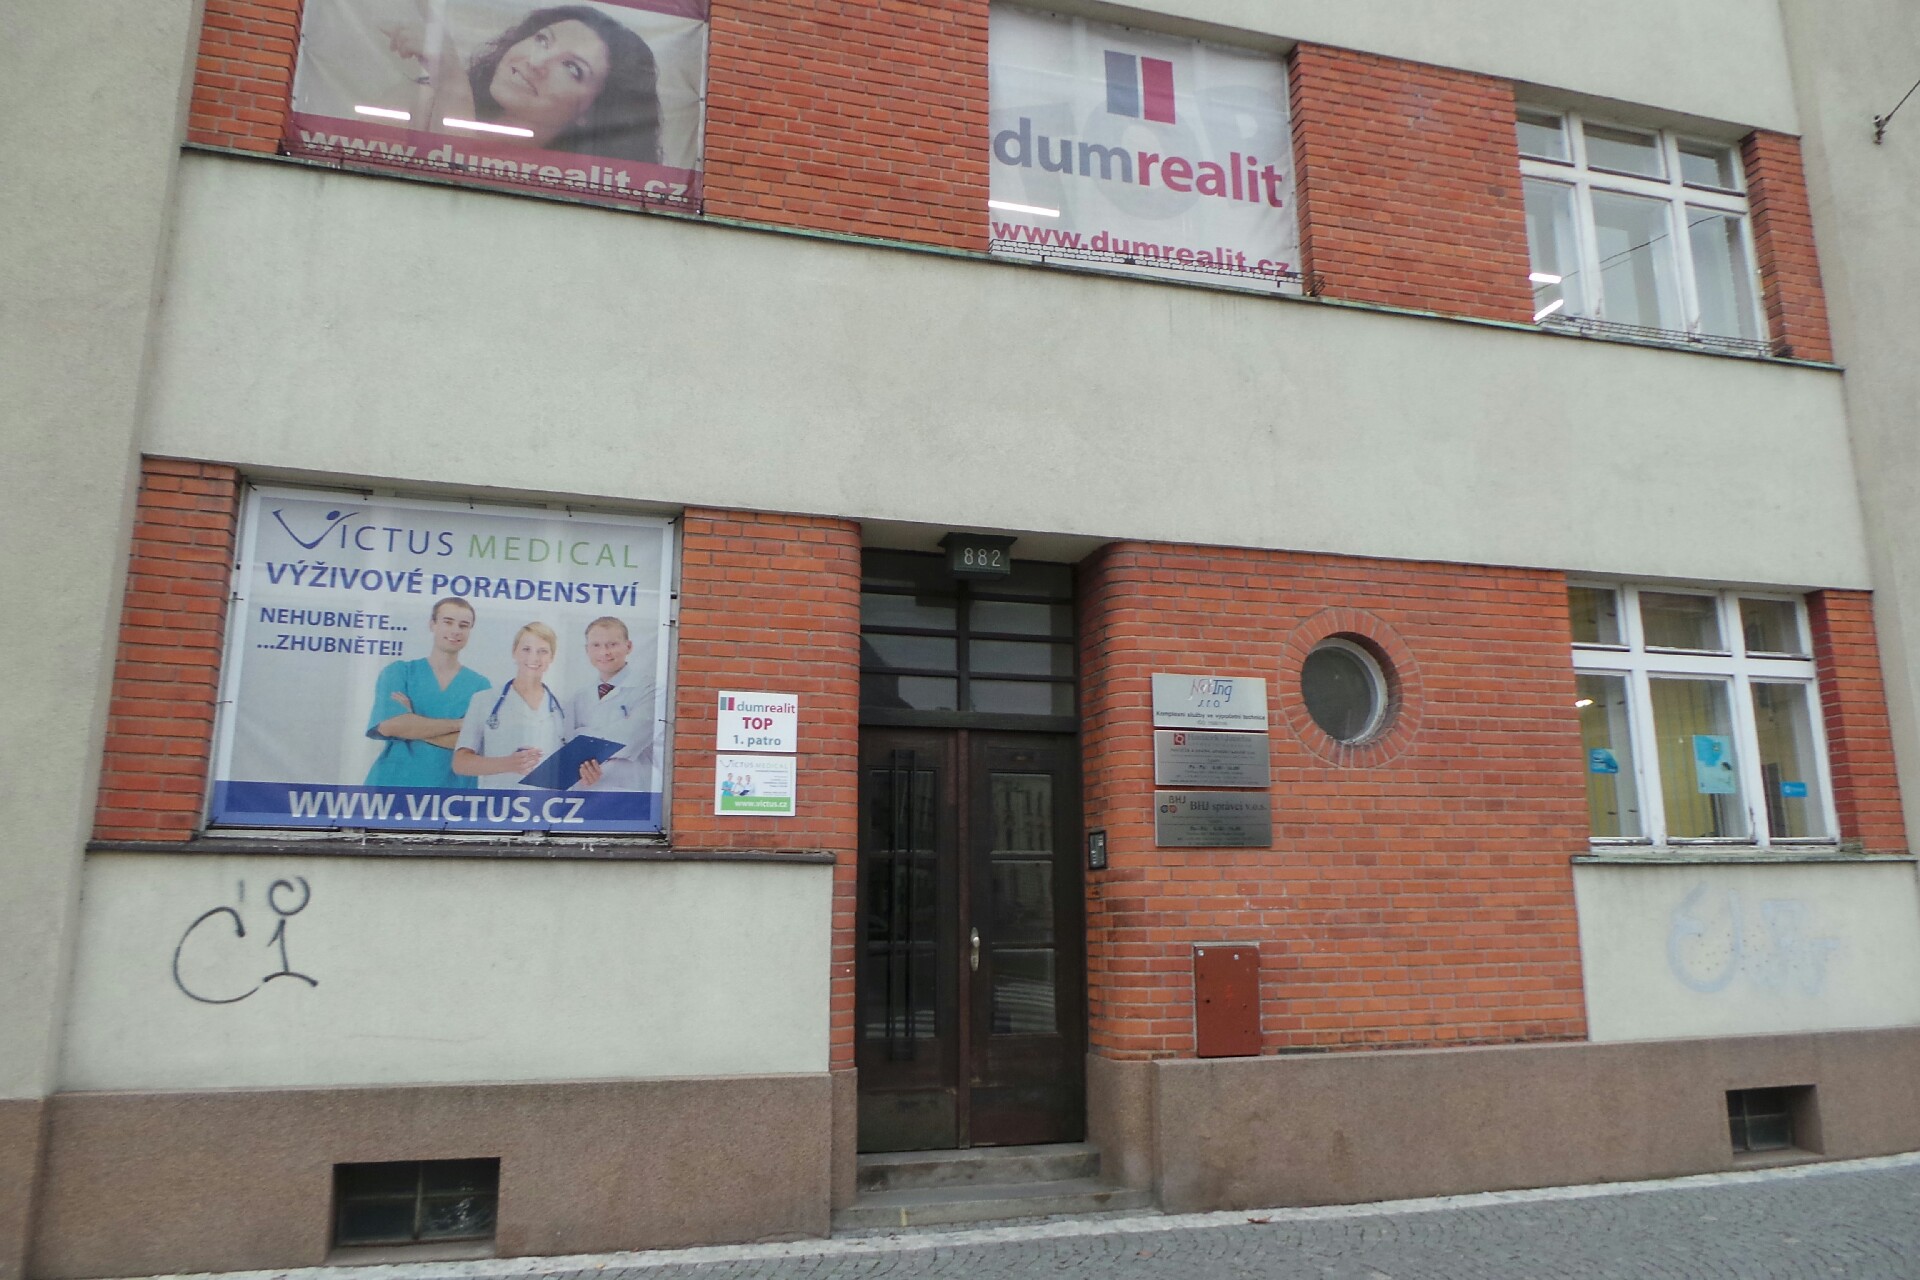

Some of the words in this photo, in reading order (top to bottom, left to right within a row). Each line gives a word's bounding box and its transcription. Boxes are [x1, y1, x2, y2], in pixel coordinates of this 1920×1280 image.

[993, 116, 1283, 209] dumrealit
[991, 221, 1290, 278] www.dumrealit.cz
[272, 509, 455, 557] VICTUS
[468, 533, 639, 569] MEDICAL
[964, 547, 1001, 567] 882
[266, 559, 424, 595] VÝŽIVOVÉ
[431, 573, 639, 607] PORADENSTVÍ
[259, 606, 408, 632] NEHUBNĚTE...
[256, 634, 405, 657] ...ZHUBNĚTE!!
[737, 701, 796, 713] dumrealit
[742, 716, 773, 730] TOP
[733, 734, 744, 745] 1.
[747, 736, 782, 748] patro
[288, 789, 586, 825] WWW.VICTUS.CZ
[1168, 795, 1186, 804] BHJ
[1190, 801, 1210, 811] BHJ
